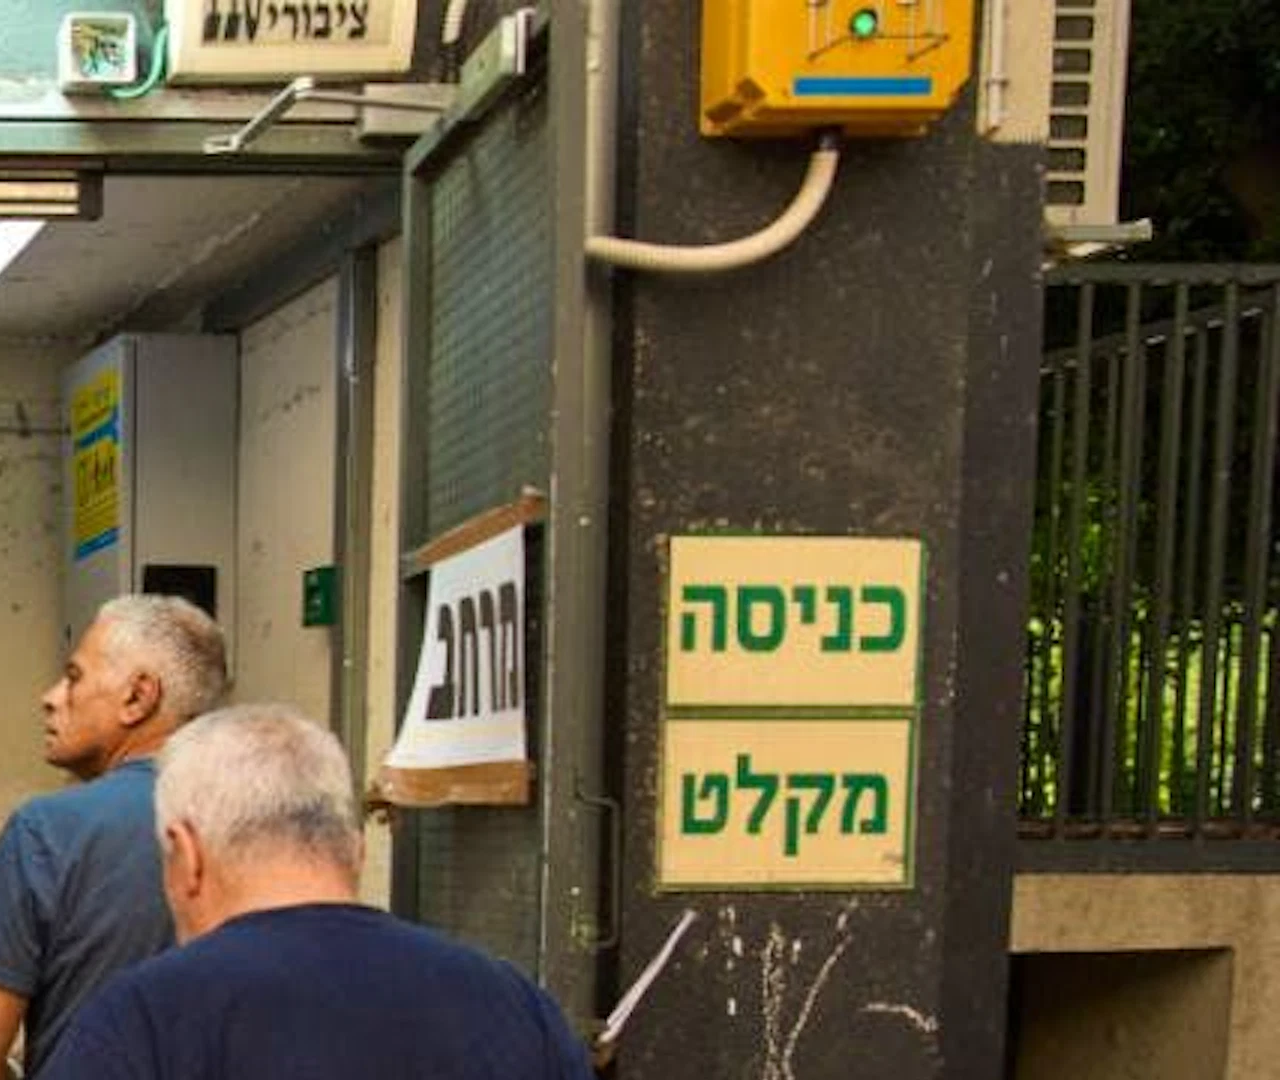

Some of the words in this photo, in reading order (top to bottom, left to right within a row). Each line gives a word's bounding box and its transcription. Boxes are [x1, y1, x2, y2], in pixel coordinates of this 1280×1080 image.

[424, 580, 519, 720] מרחב
[680, 584, 906, 654] כניסה
[680, 753, 889, 857] מקלט
